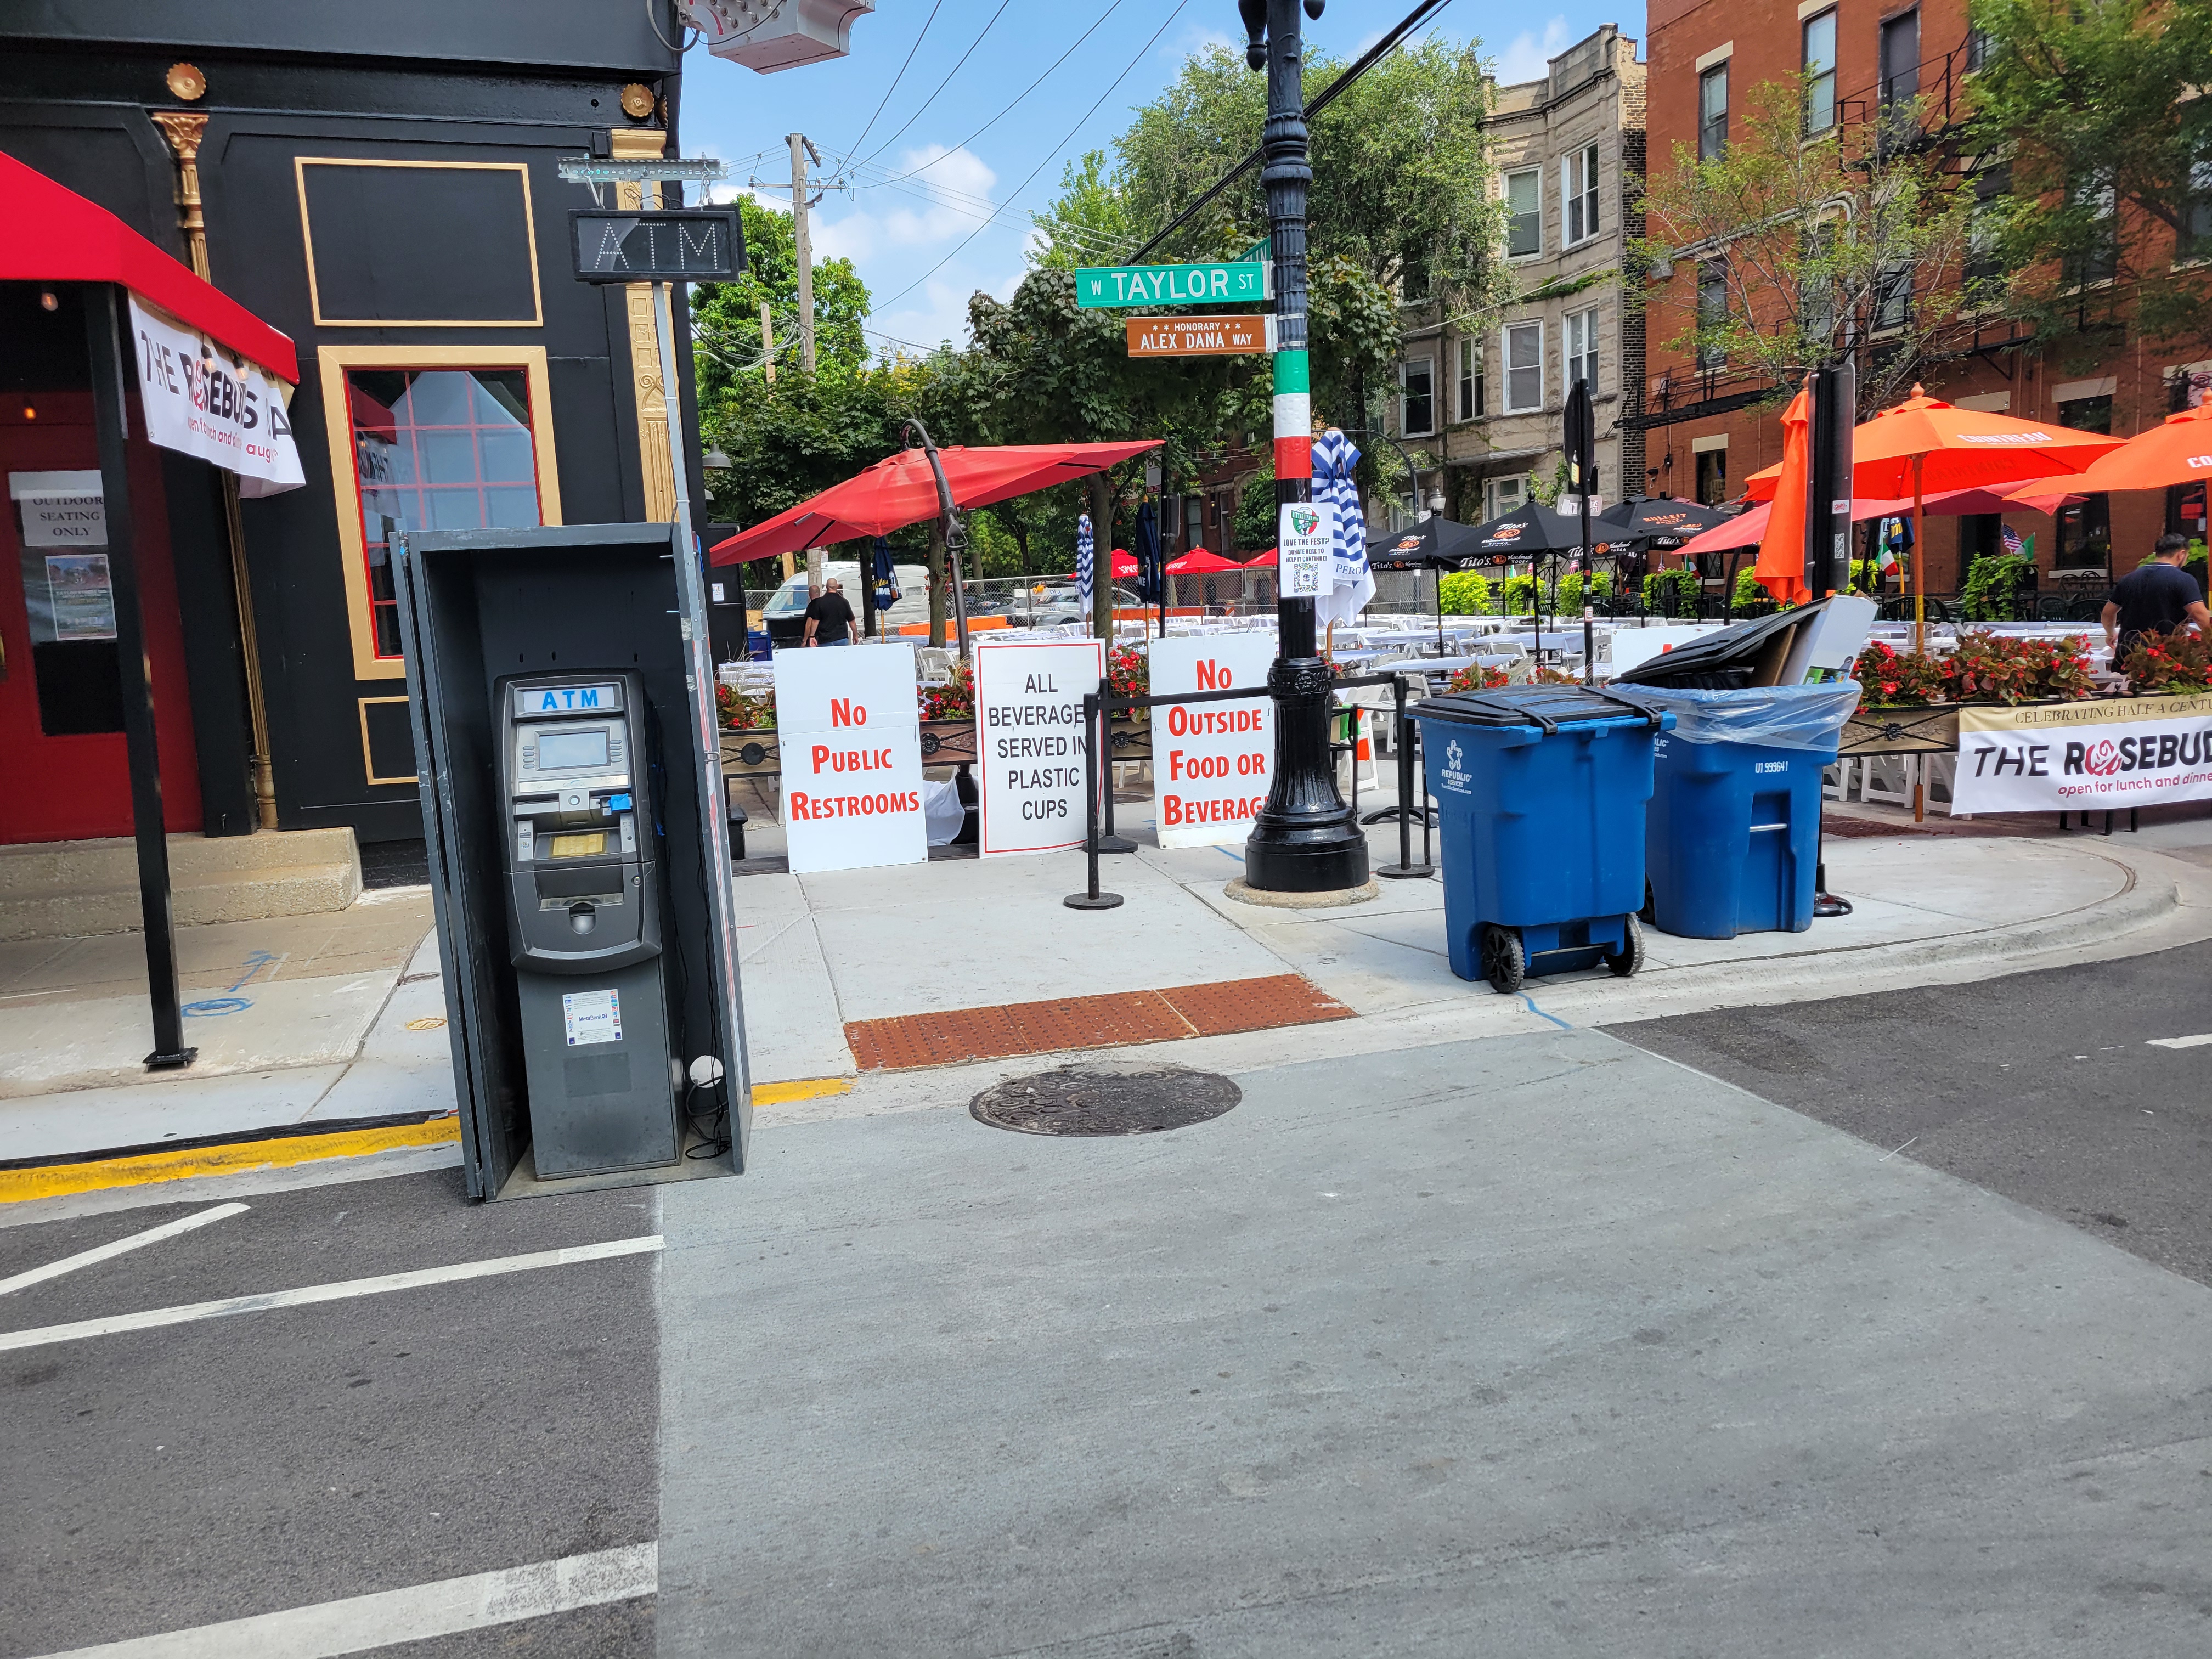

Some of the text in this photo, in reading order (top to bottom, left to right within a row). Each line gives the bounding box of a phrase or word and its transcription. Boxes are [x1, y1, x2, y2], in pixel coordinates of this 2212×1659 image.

[594, 222, 719, 270] ATM
[1091, 269, 1254, 301] W TAYLOR ST
[1174, 322, 1221, 331] HONORARY
[1141, 332, 1252, 349] ALEX DANA WAY
[140, 329, 180, 395] THE
[1957, 432, 2053, 443] COINTREAU
[33, 496, 104, 506] OUTDOOR
[40, 512, 100, 521] SEATING
[1643, 513, 1687, 522] BULLEIT
[53, 527, 91, 537] ONLY
[1310, 537, 1330, 545] FEST?
[1025, 673, 1058, 693] ALL
[1197, 659, 1232, 691] NO
[541, 689, 599, 710] ATM
[831, 698, 867, 727] NO
[1168, 706, 1263, 737] OUTSIDE
[2015, 707, 2114, 724] CELEBRATING
[2117, 703, 2154, 716] HALF
[2155, 703, 2165, 713] A
[998, 735, 1087, 758] SERVED IN
[811, 744, 893, 774] PUBLIC
[1170, 750, 1266, 781] FOOD OR
[1764, 761, 1788, 773] 999641
[1973, 744, 2050, 777] THE
[1008, 767, 1080, 789] PLASTIC
[2058, 785, 2093, 798] open
[2095, 781, 2113, 793] for
[2116, 777, 2152, 791] lunch
[2155, 774, 2180, 787] and
[790, 791, 920, 821] RESTROOMS
[1022, 799, 1068, 820] CUPS
[1164, 794, 1268, 826] BEVERAG
